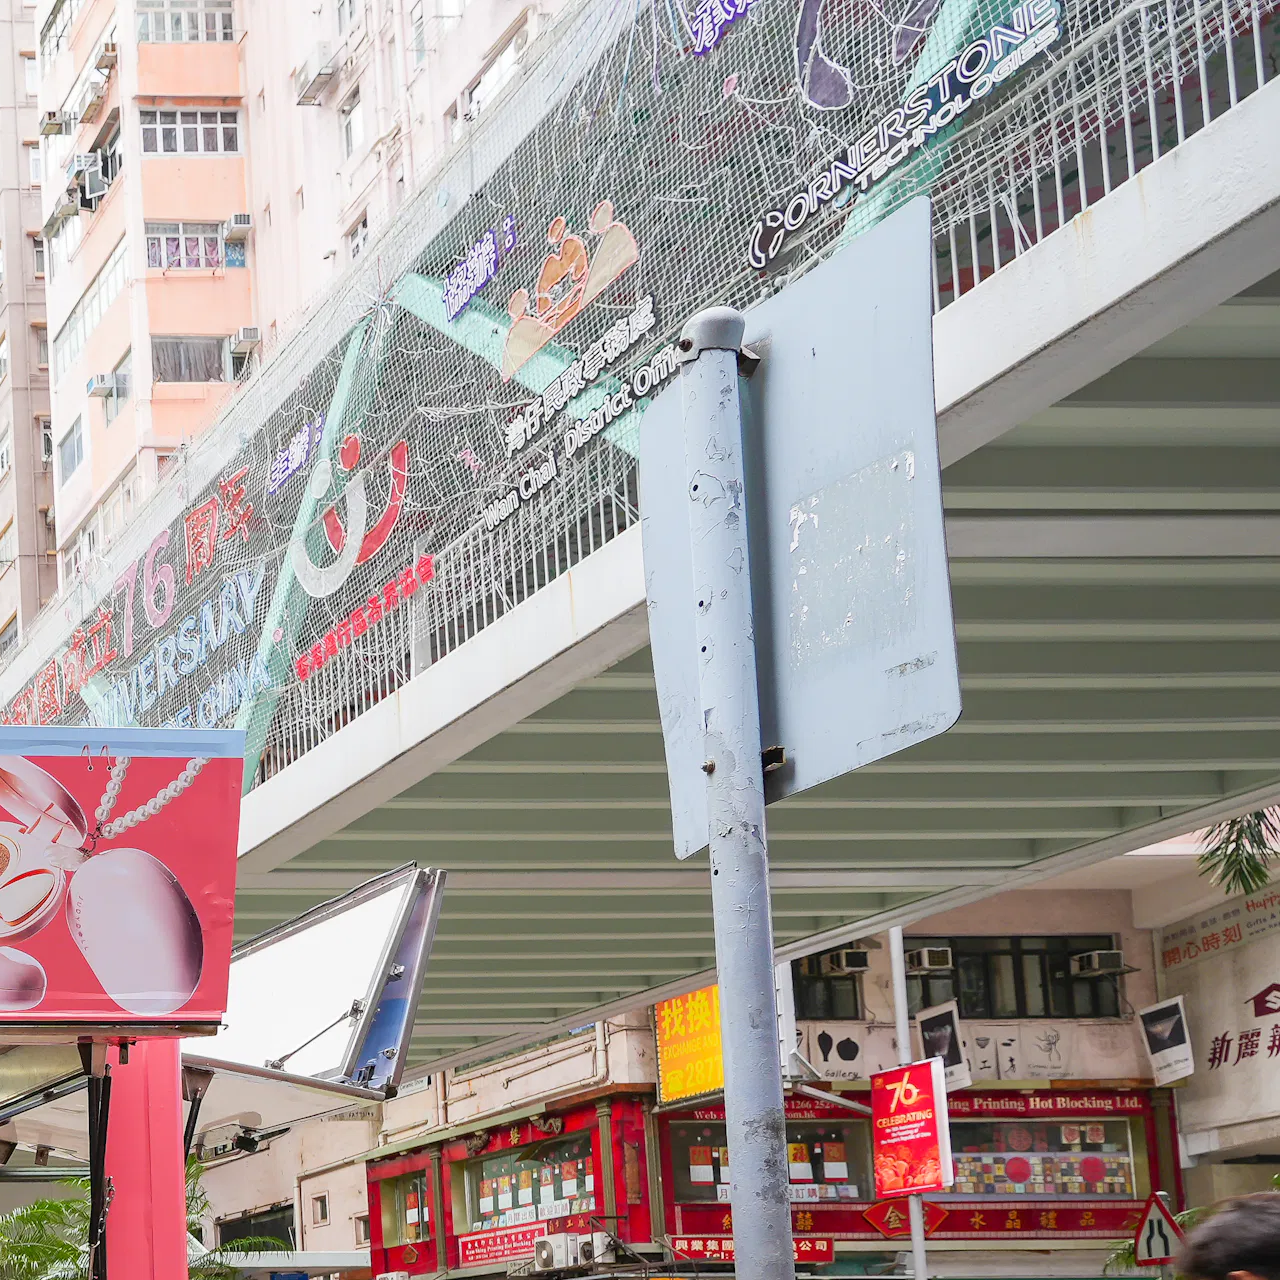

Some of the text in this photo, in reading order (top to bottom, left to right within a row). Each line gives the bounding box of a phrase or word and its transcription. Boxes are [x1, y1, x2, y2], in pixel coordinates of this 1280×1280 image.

[854, 22, 1061, 191] TECHNOLOGIES
[482, 342, 683, 531] Wan Chai District Offic
[1162, 923, 1244, 969] 開心時刻
[660, 986, 721, 1041] 找換
[663, 1033, 720, 1060] EXCHANGE AND
[824, 1068, 862, 1081] Gallery
[791, 1101, 812, 1109] 1266
[885, 1071, 920, 1113] 76
[973, 1097, 1025, 1112] Printing
[1029, 1096, 1054, 1109] Hot
[1056, 1096, 1113, 1111] Blocking
[1116, 1096, 1142, 1109] Ltd.
[694, 1110, 717, 1120] Web
[877, 1109, 932, 1129] CELEBRATING
